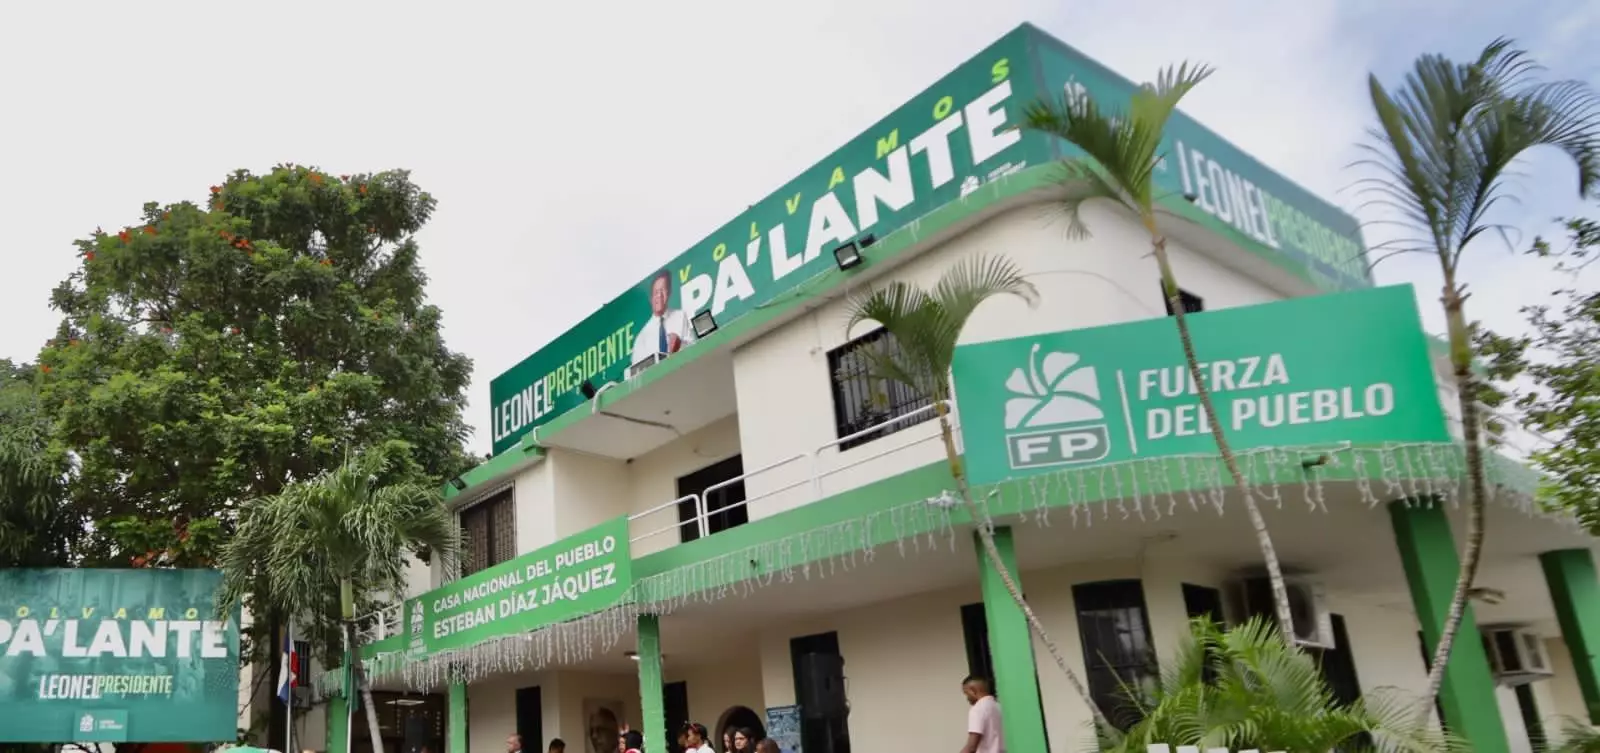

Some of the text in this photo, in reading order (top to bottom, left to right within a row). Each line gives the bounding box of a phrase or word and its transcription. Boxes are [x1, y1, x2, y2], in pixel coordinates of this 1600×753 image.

[679, 58, 1009, 283] VOLVAMOS
[680, 79, 1022, 327] PA'LANTE
[1176, 140, 1280, 250] LEONEL
[494, 321, 634, 442] LEONEL PRESIDENTE
[1138, 353, 1289, 401] FUERZA
[1145, 382, 1395, 440] DEL PUEBLO
[1017, 431, 1100, 464] FP
[16, 606, 198, 619] OLVAMO
[433, 535, 616, 613] CASA NACIONAL DEL PUEBLO
[433, 563, 617, 640] ESTEBAN DÍAZ JÁQUEZ
[39, 674, 101, 699] LEONEL
